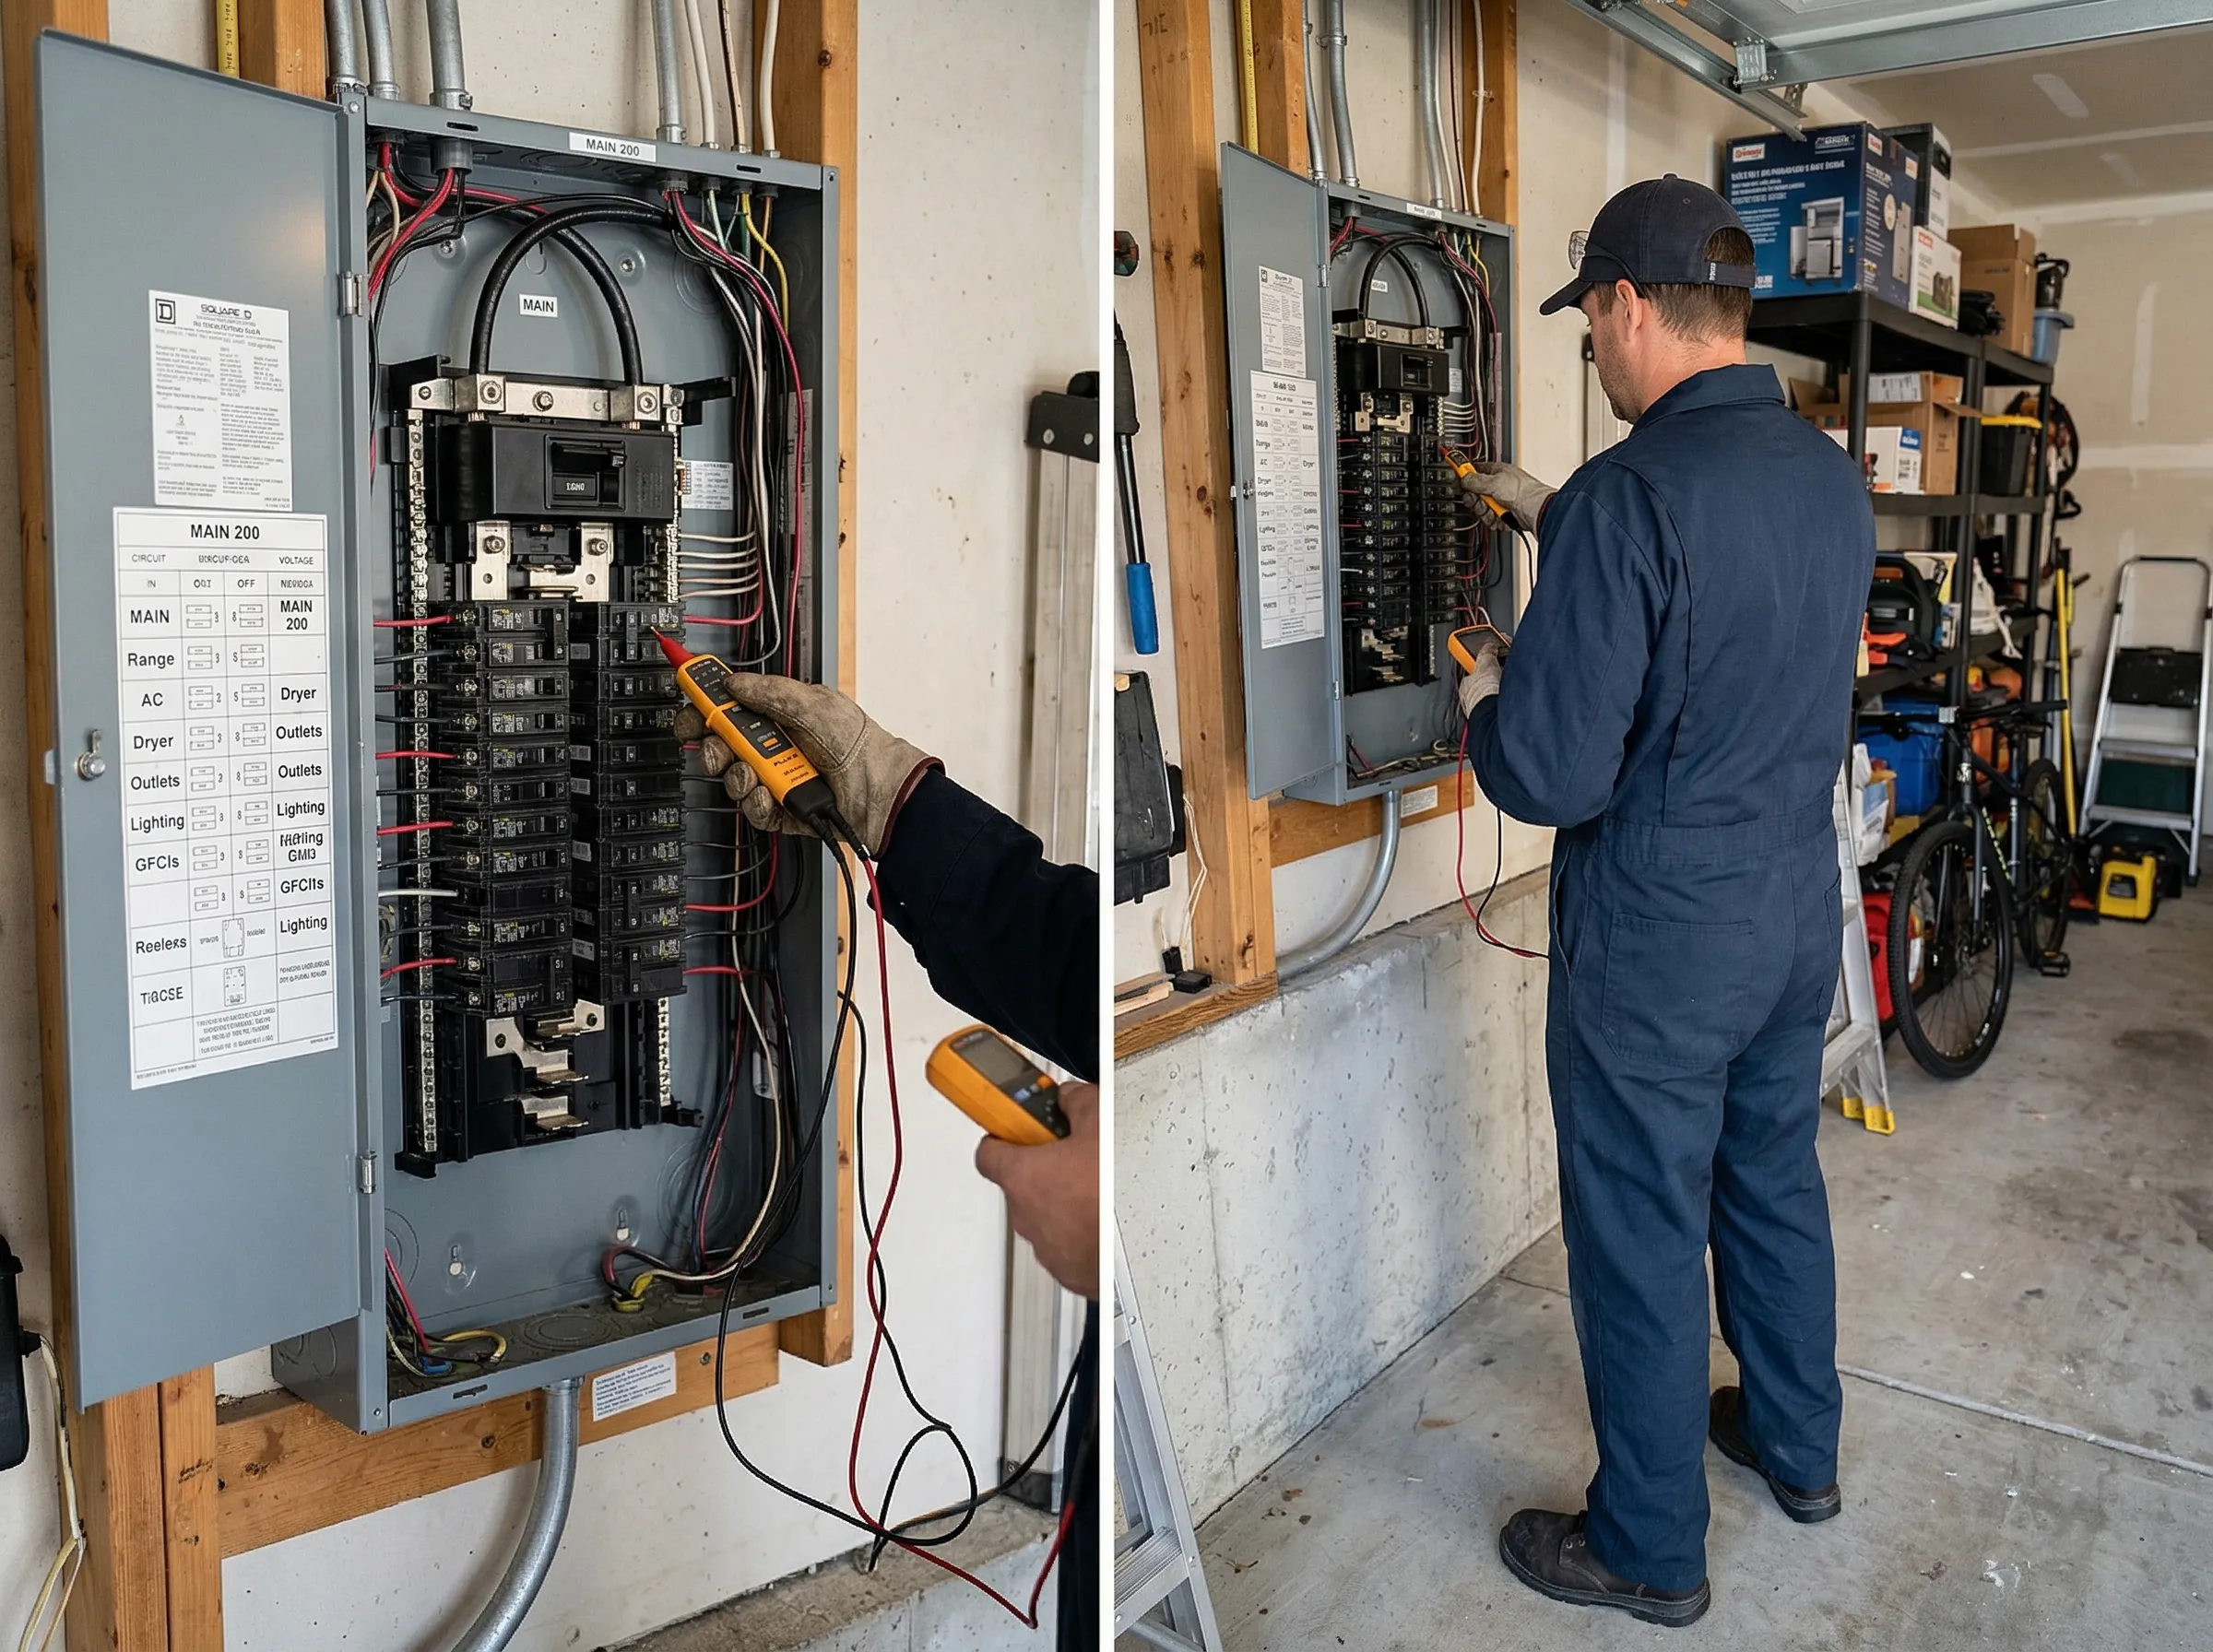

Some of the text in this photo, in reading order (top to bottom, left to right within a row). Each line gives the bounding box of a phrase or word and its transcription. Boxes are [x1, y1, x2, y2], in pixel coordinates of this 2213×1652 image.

[586, 138, 640, 157] MAIN 200
[523, 298, 554, 313] MAIN
[190, 524, 260, 540] MAIN 200
[131, 553, 167, 563] CIRCUIT
[278, 556, 314, 565] VOLTAGE
[237, 579, 255, 589] OFF
[280, 599, 313, 613] MAIN
[130, 609, 170, 624] MAIN
[286, 617, 308, 631] 200
[127, 652, 175, 670] Range
[141, 692, 163, 707] AC
[280, 687, 317, 703] Dryer
[276, 725, 323, 740] Outlets
[133, 735, 174, 752] Dryer
[278, 763, 323, 779] Outlets
[130, 774, 181, 791] Outlets
[277, 800, 325, 819] Lighting
[131, 814, 184, 834] Lighting
[279, 915, 327, 936] Lighting
